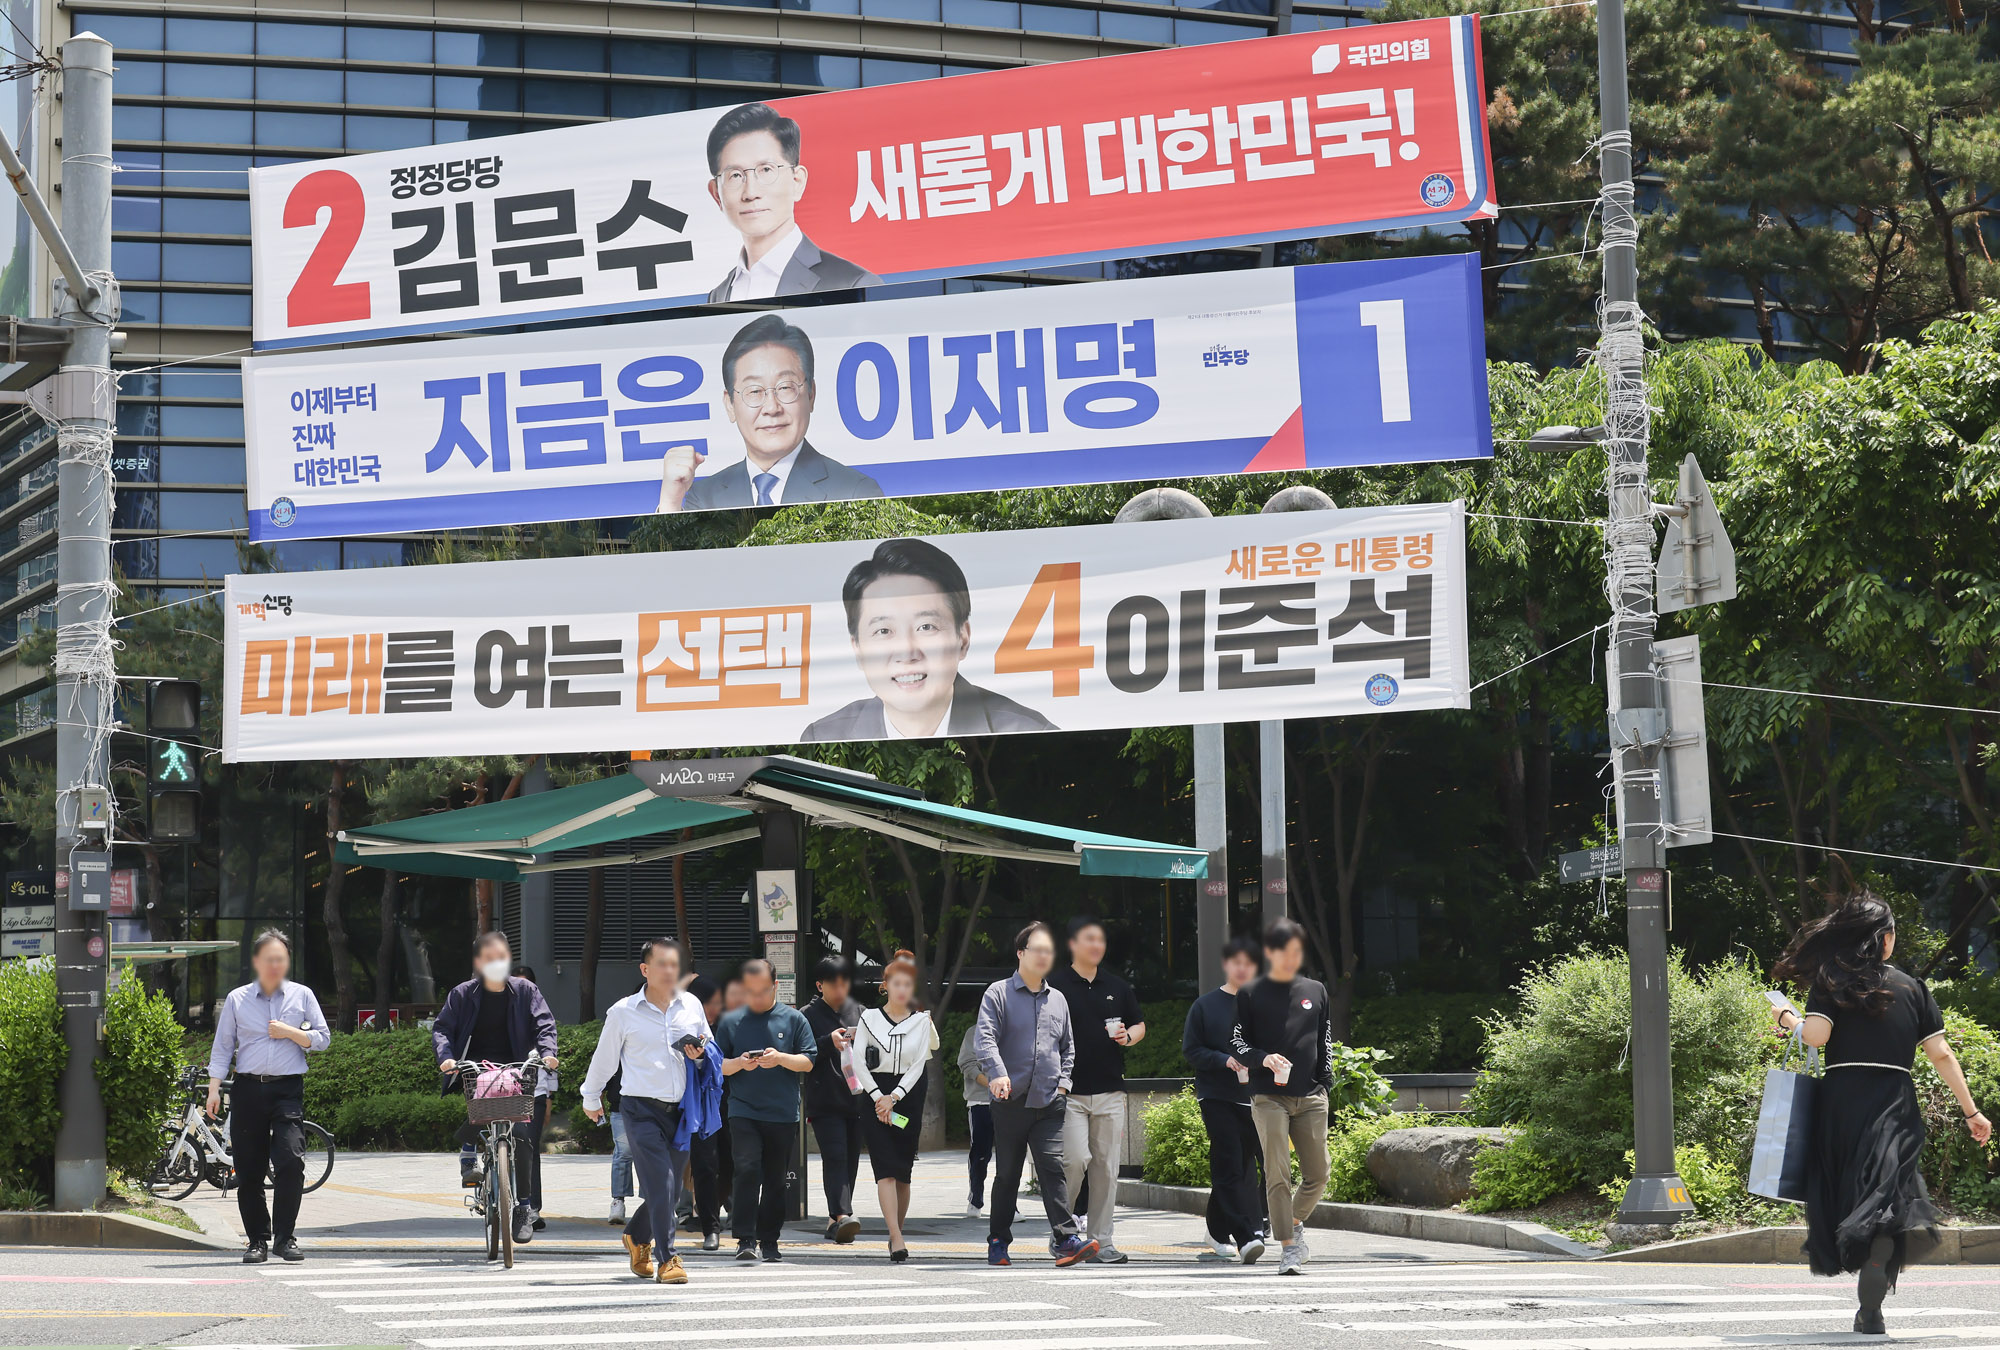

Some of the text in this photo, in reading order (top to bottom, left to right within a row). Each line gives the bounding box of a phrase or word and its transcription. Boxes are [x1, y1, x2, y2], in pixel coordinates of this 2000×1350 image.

[1347, 37, 1431, 67] 국민의힘
[849, 87, 1421, 224] 새롭게 대한민국!
[390, 155, 504, 200] 정정당당
[1427, 184, 1447, 198] 선거
[282, 168, 694, 328] 2 김문수
[1202, 350, 1250, 368] 민주당
[1358, 298, 1412, 424] 1
[290, 383, 377, 416] 이제부터
[423, 318, 1161, 474] 지금은 이재명
[292, 421, 336, 452] 진짜
[110, 457, 150, 470] 셋증권
[293, 455, 382, 487] 대한민국
[1224, 532, 1434, 581] 새로운 대통령
[236, 593, 293, 621] 개혁신당
[994, 562, 1433, 698] 4 이준석
[240, 612, 804, 717] 미래를 여는 선택
[657, 767, 736, 785] MAPO 마포구
[17, 885, 49, 896] S-OIL
[3, 918, 19, 929] Top
[20, 915, 46, 927] Cloud
